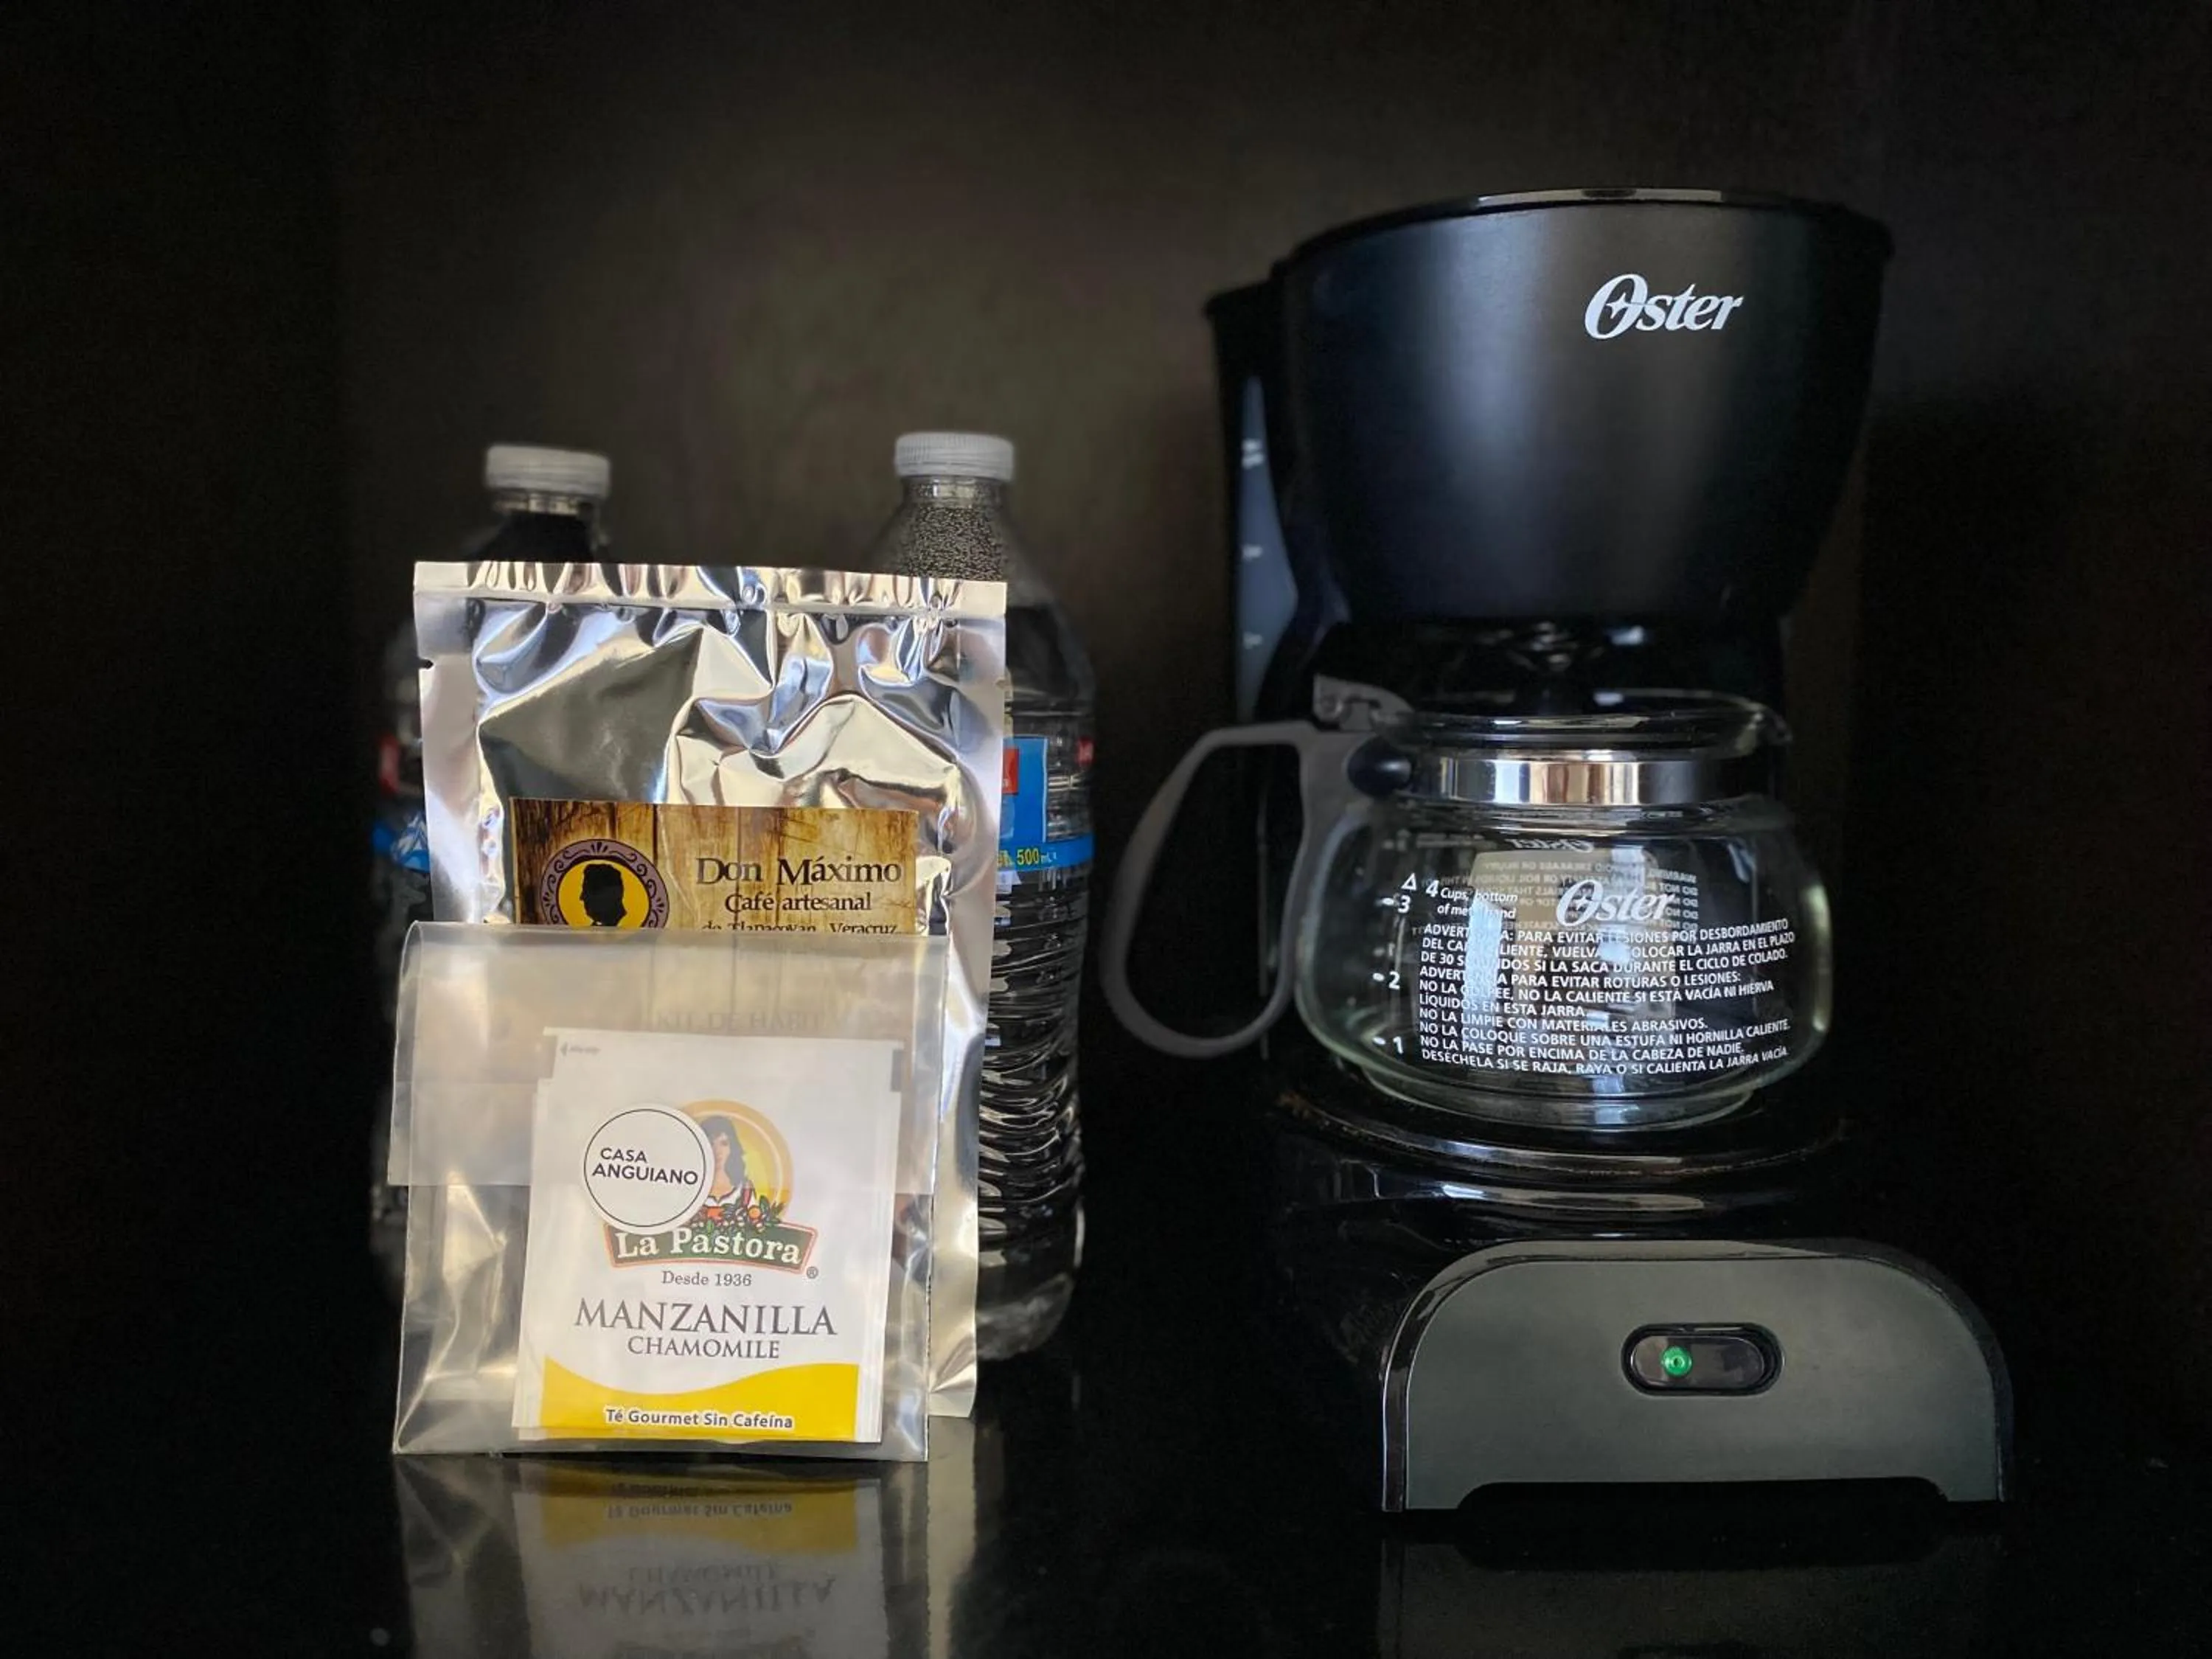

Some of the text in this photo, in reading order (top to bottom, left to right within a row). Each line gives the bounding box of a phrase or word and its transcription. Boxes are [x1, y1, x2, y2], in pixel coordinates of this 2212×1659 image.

[1585, 274, 1744, 339] Oster
[1017, 849, 1040, 865] 500
[696, 855, 902, 886] Don Máximo
[725, 891, 872, 913] Café artesanal
[1425, 880, 1439, 898] 4
[1440, 887, 1469, 902] Cups,
[1475, 888, 1518, 903] bottom
[1556, 879, 1676, 927] Oster
[1397, 894, 1411, 914] 3
[1437, 903, 1450, 915] of
[1424, 923, 1514, 941] ADVERTA:
[1517, 931, 1553, 942] PARA
[1557, 931, 1604, 944] EVITAR
[1608, 931, 1668, 944] LESIONES
[1672, 930, 1696, 942] POR
[1700, 918, 1788, 941] DESBORDAMIENTO
[1422, 937, 1444, 950] DEL
[1622, 944, 1684, 958] OLOCAR
[1688, 945, 1703, 956] LA
[1705, 942, 1740, 956] JARRA
[1743, 939, 1756, 951] EN
[1758, 936, 1768, 948] EL
[1770, 931, 1795, 947] PLAZO
[1421, 951, 1436, 963] DE
[1439, 953, 1453, 964] 30
[1534, 960, 1545, 971] SI
[1550, 961, 1568, 973] LA
[1572, 961, 1609, 973] SACA
[1613, 961, 1675, 973] DURANTE
[1679, 959, 1693, 971] EL
[1696, 956, 1729, 970] CICLO
[1732, 955, 1745, 967] DE
[1748, 948, 1789, 964] COLADO.
[1388, 971, 1401, 990] 2
[1512, 974, 1548, 987] PARA
[1552, 976, 1599, 988] EVITAR
[1604, 976, 1666, 988] ROTURAS
[1671, 975, 1680, 987] O
[1684, 971, 1741, 985] LESIONES:
[1419, 980, 1438, 992] NO
[1441, 982, 1457, 995] LA
[1518, 990, 1540, 1001] NO
[1545, 991, 1564, 1002] LA
[1566, 992, 1630, 1004] CALIENTE
[1635, 991, 1646, 1003] SI
[1649, 987, 1682, 1002] ESTÁ
[1685, 984, 1722, 1000] VACÍA
[1724, 986, 1736, 998] NI
[1739, 980, 1775, 995] HIERVA
[1419, 993, 1478, 1009] LÍQUIDOS
[1483, 1001, 1499, 1013] EN
[1504, 1003, 1536, 1015] ESTA
[1419, 1008, 1708, 1032] NO LA LIMPIE CON MATERIALES ABRASIVOS.
[1419, 1018, 1791, 1047] NO LA COLOQUE SOBRE UNA ESTUFA NI HORNILLA CALIENTE.
[1392, 1036, 1404, 1054] 1
[1420, 1035, 1744, 1061] NO LA PASE POR ENCIMA DE LA CABEZA DE NADIE.
[1422, 1049, 1494, 1068] DESÉCHELA
[1497, 1059, 1509, 1070] SI
[1513, 1060, 1528, 1071] SE
[1576, 1062, 1613, 1074] RAYA
[1615, 1063, 1627, 1074] O
[1632, 1063, 1643, 1074] SI
[1646, 1061, 1706, 1074] CALIENTA
[1709, 1058, 1724, 1070] LA
[1726, 1052, 1759, 1068] JARRA
[600, 1148, 648, 1164] CASA
[591, 1163, 698, 1185] ANGUIANO
[615, 1226, 803, 1265] La Pastora
[661, 1270, 752, 1287] Desde 1936
[574, 1298, 837, 1335] MANZANILLA
[627, 1336, 780, 1360] CHAMOMILE
[606, 1409, 792, 1428] Té Gourmet Sin Cafeína
